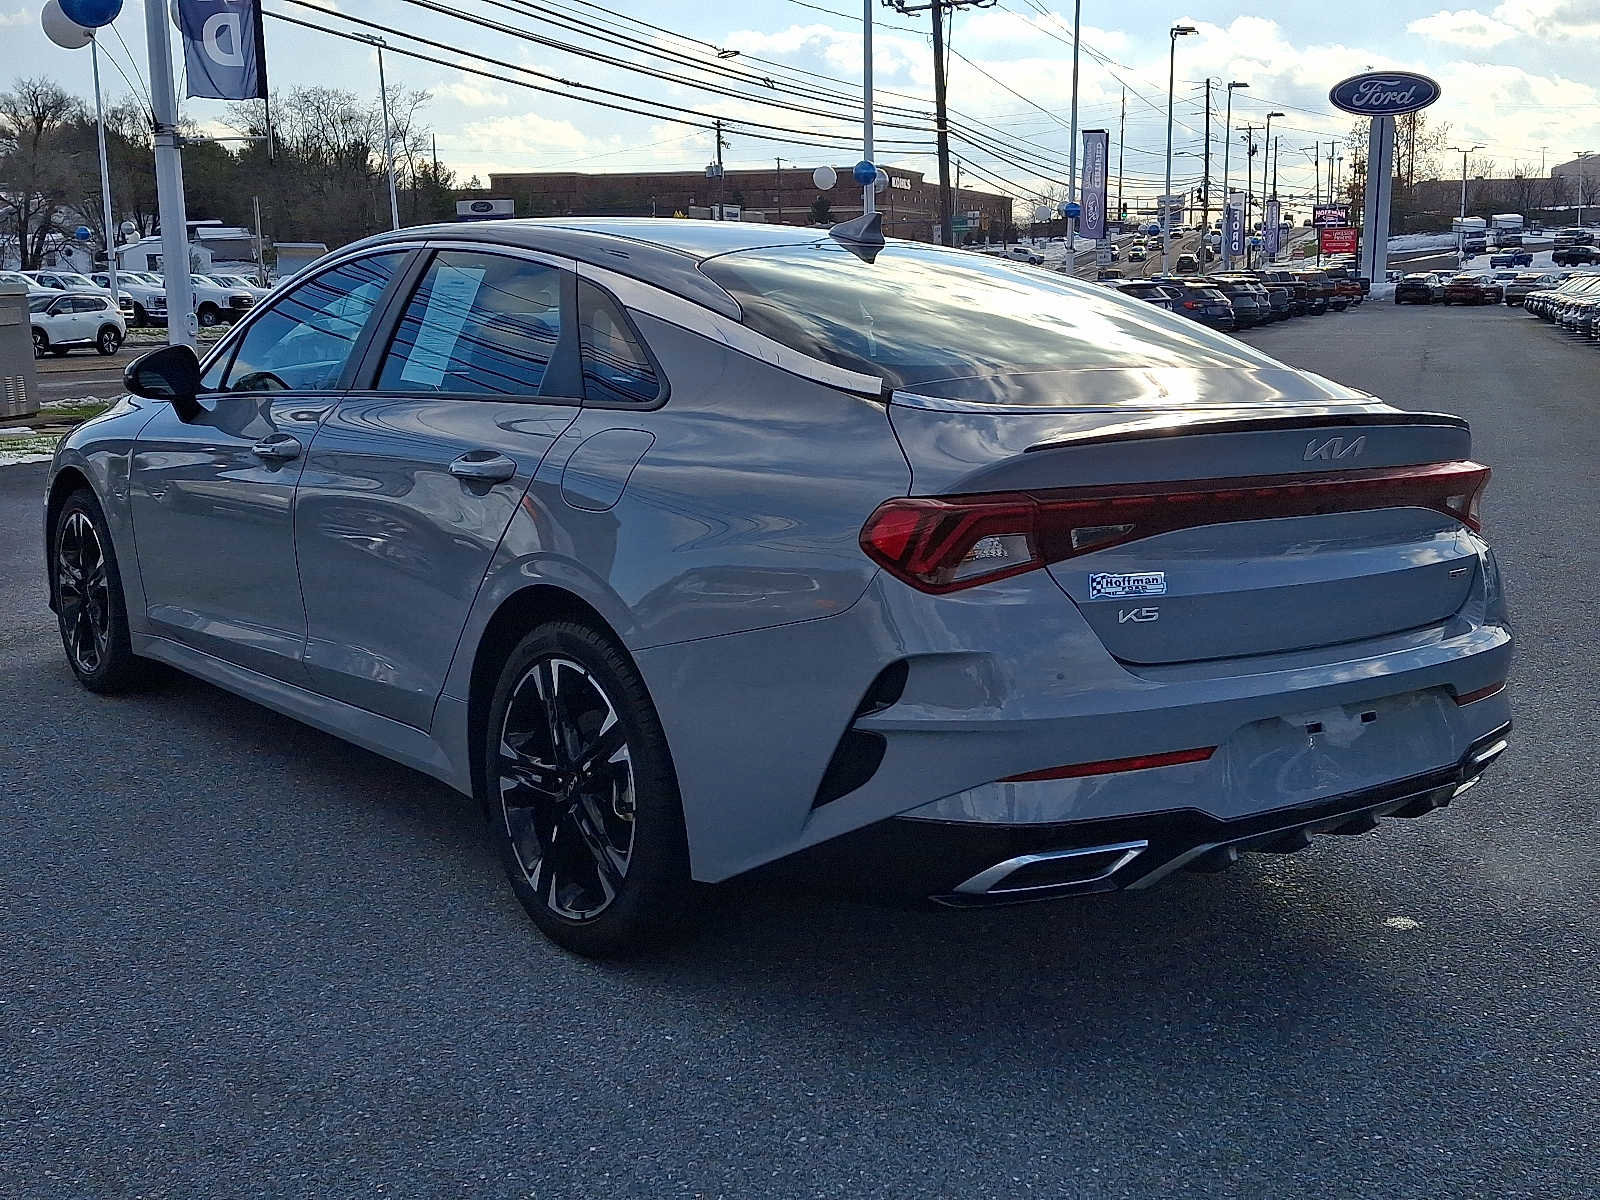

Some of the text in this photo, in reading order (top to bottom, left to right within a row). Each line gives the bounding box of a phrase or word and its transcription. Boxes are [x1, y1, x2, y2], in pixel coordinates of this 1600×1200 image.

[1352, 80, 1416, 106] Ford
[1105, 576, 1159, 587] Hoffman
[1118, 606, 1159, 624] K5
